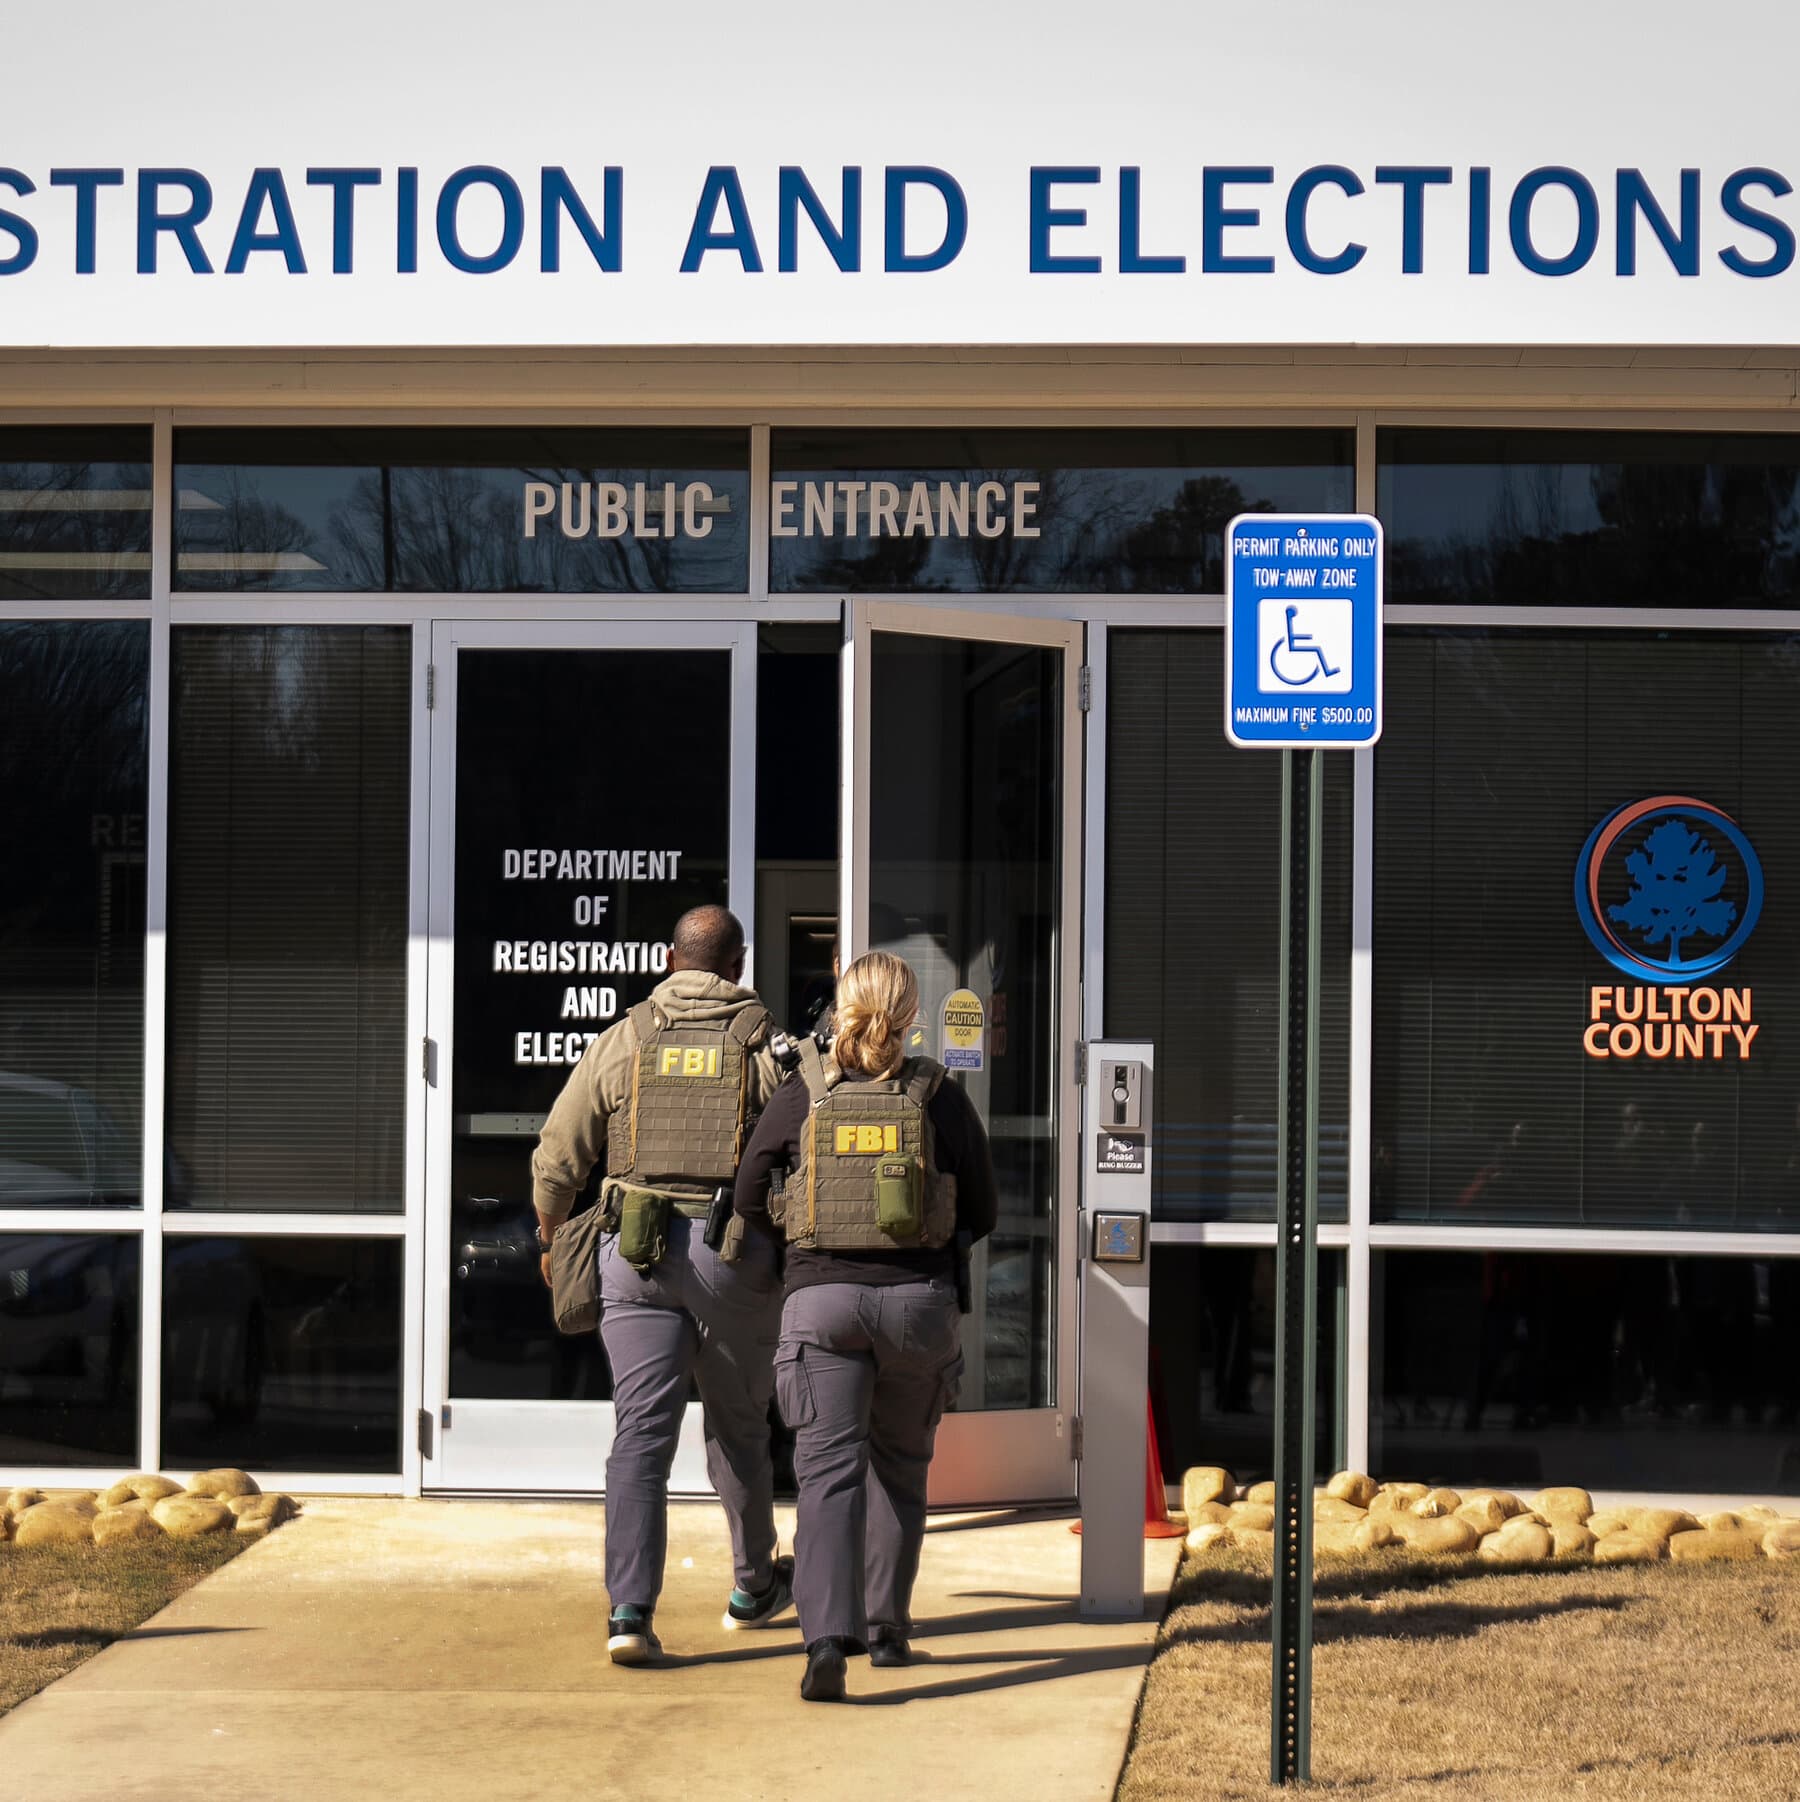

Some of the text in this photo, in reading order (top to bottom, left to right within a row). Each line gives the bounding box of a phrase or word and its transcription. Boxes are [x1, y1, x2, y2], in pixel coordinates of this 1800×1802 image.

[680, 167, 967, 273] AND
[1029, 166, 1796, 278] ELECTIONS
[523, 481, 1041, 538] PUBLIC ENTRANCE
[1234, 537, 1376, 557] PERMIT PARKING ONLY
[1253, 567, 1357, 587] TOW-AWAY ZONE
[1236, 707, 1373, 724] MAXIMUM FINE $500.00
[503, 849, 683, 881] DEPARTMENT
[574, 895, 609, 926] OF
[493, 940, 674, 974] REGISTRATIO
[561, 986, 617, 1019] AND
[948, 1000, 980, 1009] AUTOMATIC
[1590, 986, 1752, 1022] FULTON
[945, 1013, 982, 1025] CAUTION
[955, 1028, 972, 1036] DOOR
[1583, 1023, 1759, 1060] COUNTY
[661, 1047, 717, 1076] FBI
[834, 1124, 898, 1154] FBI
[1107, 1152, 1134, 1161] Please
